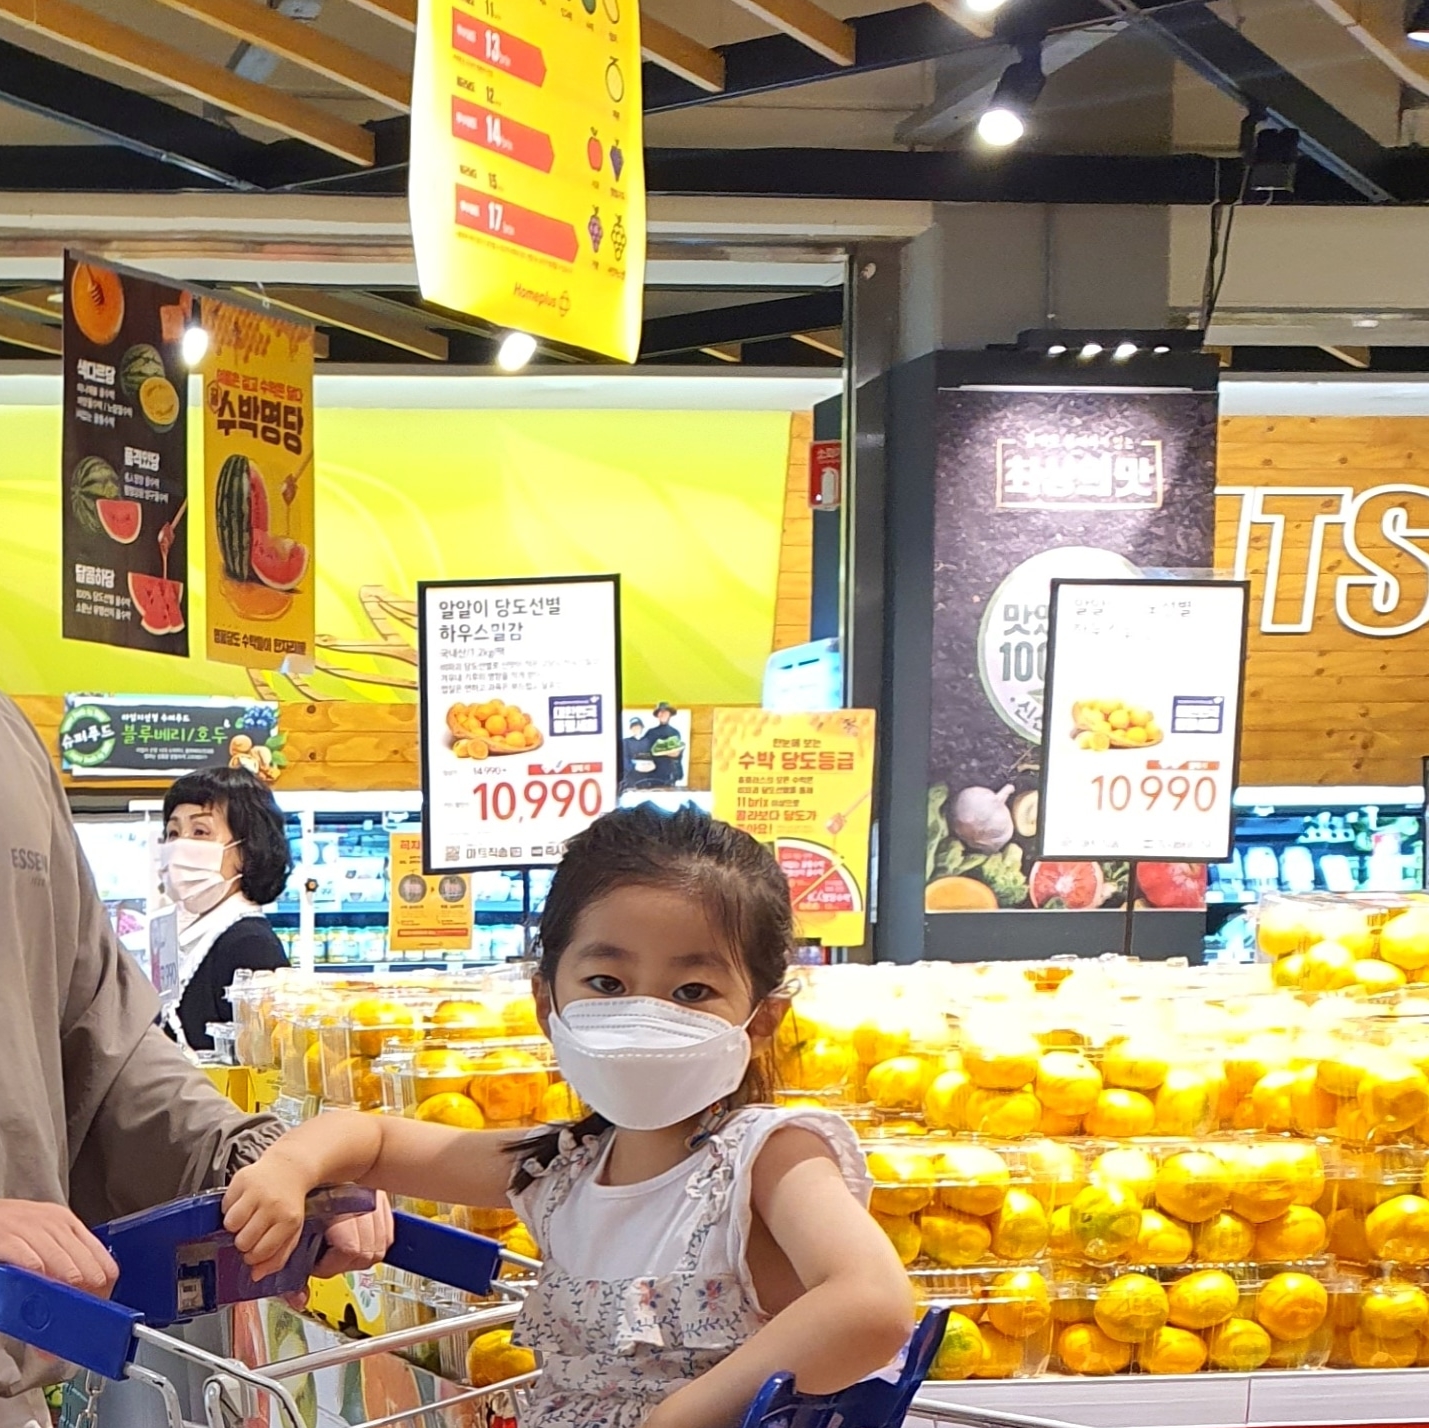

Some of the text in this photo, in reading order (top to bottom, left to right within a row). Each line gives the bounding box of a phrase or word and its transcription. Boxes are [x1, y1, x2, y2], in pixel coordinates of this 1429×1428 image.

[514, 281, 556, 308] Homeplus
[217, 390, 303, 455] 수박명당
[439, 596, 561, 620] 알알이 당도선별
[439, 622, 523, 643] 하우스밀감
[62, 724, 115, 750] 슈퍼푸드
[738, 751, 854, 770] 수박 당도등급
[473, 778, 603, 823] 10,990
